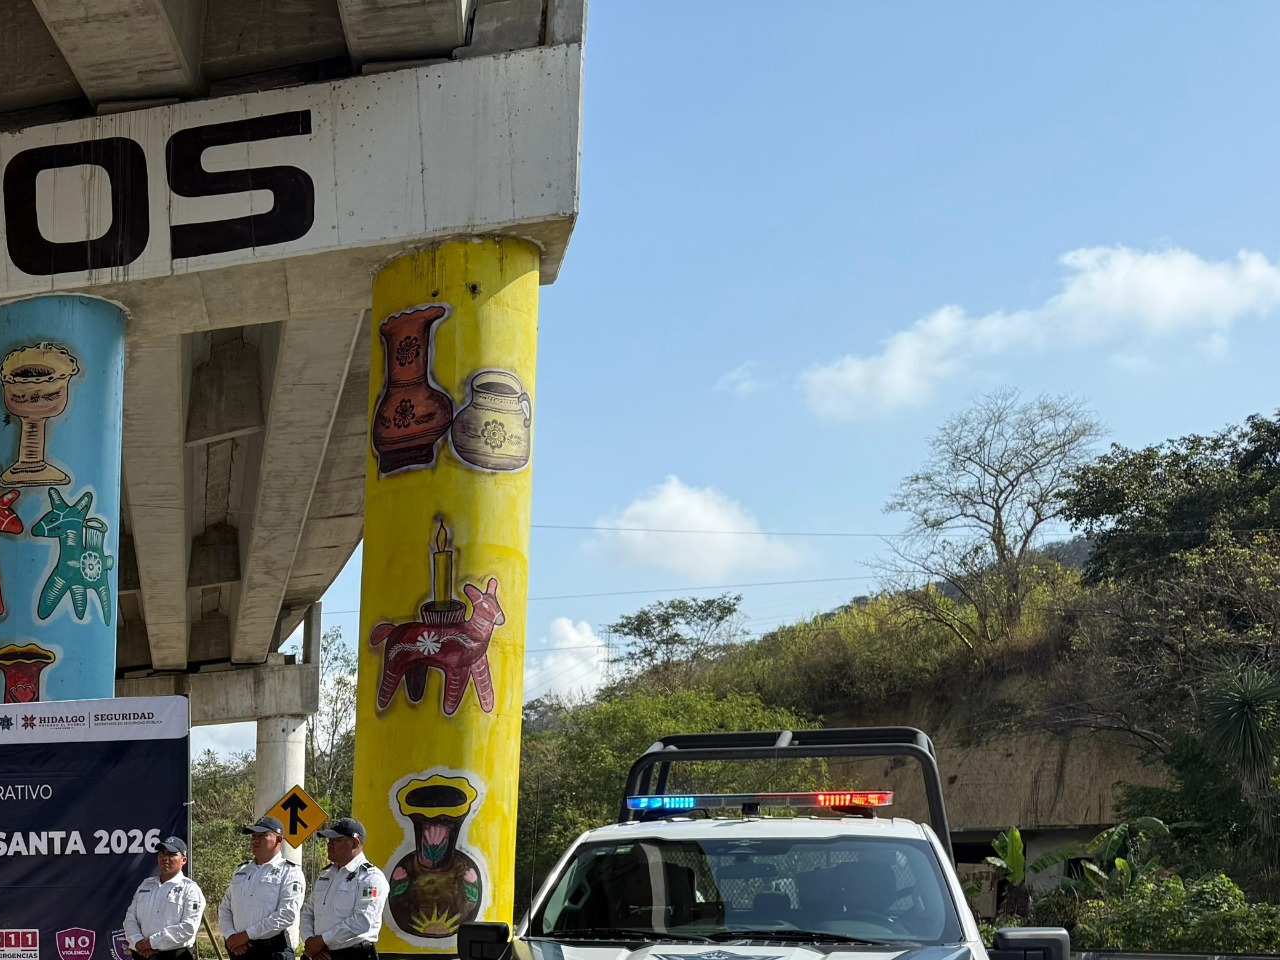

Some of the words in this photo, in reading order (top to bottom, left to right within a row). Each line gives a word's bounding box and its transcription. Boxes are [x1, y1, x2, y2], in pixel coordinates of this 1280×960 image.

[39, 715, 85, 724] HIDALGO
[94, 712, 154, 721] SEGURIDAD
[93, 828, 162, 855] 2026
[64, 935, 90, 949] NO
